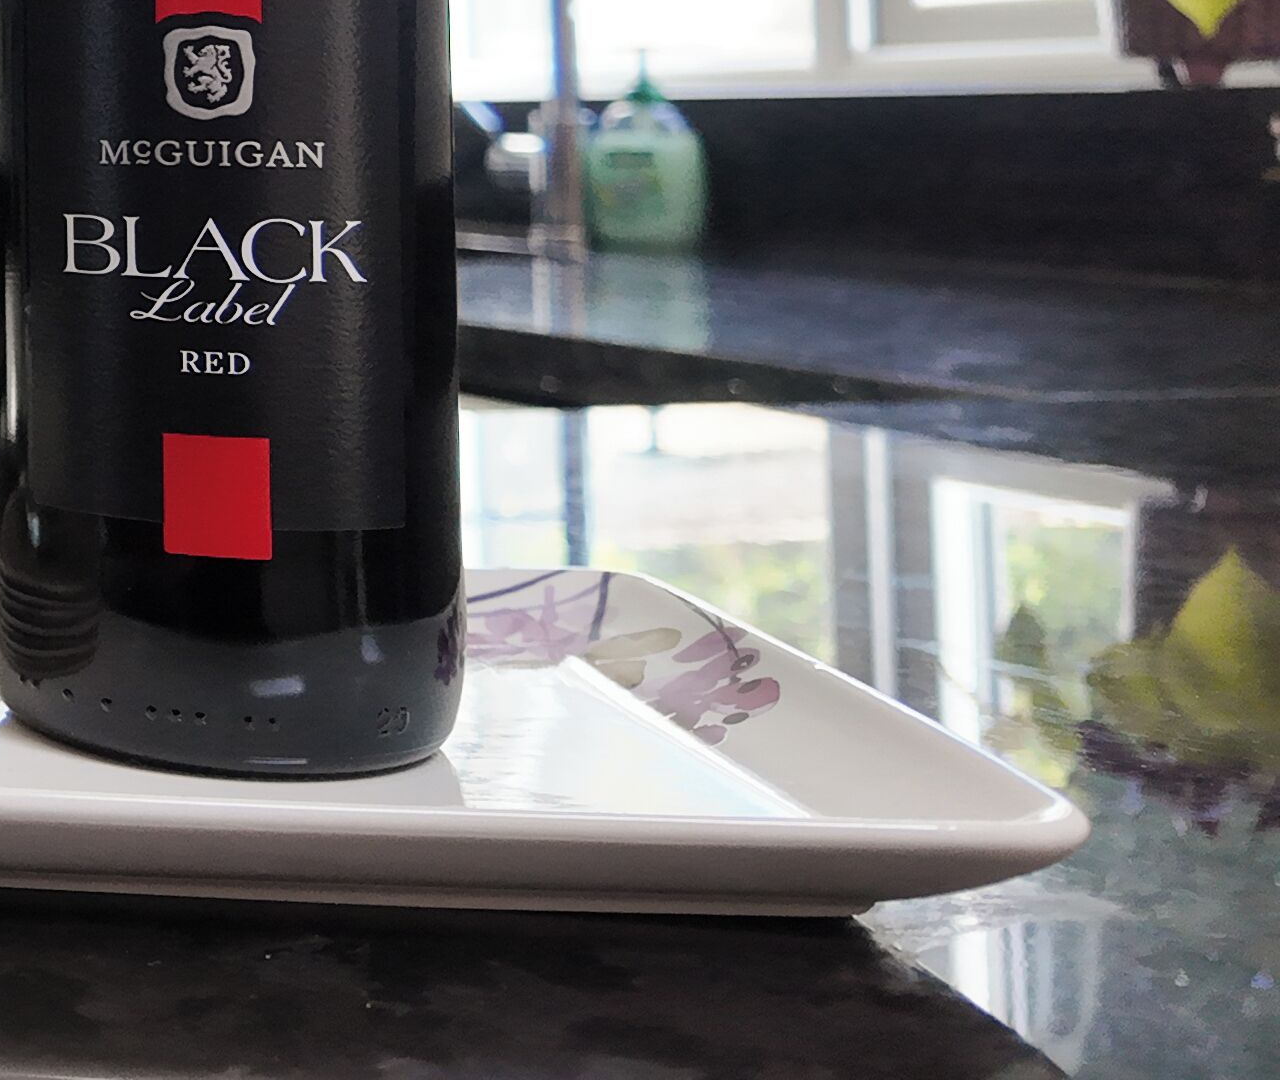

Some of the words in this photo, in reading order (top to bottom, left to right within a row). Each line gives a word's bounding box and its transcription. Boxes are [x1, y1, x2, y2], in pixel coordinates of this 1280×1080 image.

[98, 138, 326, 169] McGUIGAN
[62, 212, 368, 284] BLACK
[129, 279, 296, 326] Label
[179, 350, 251, 375] RED
